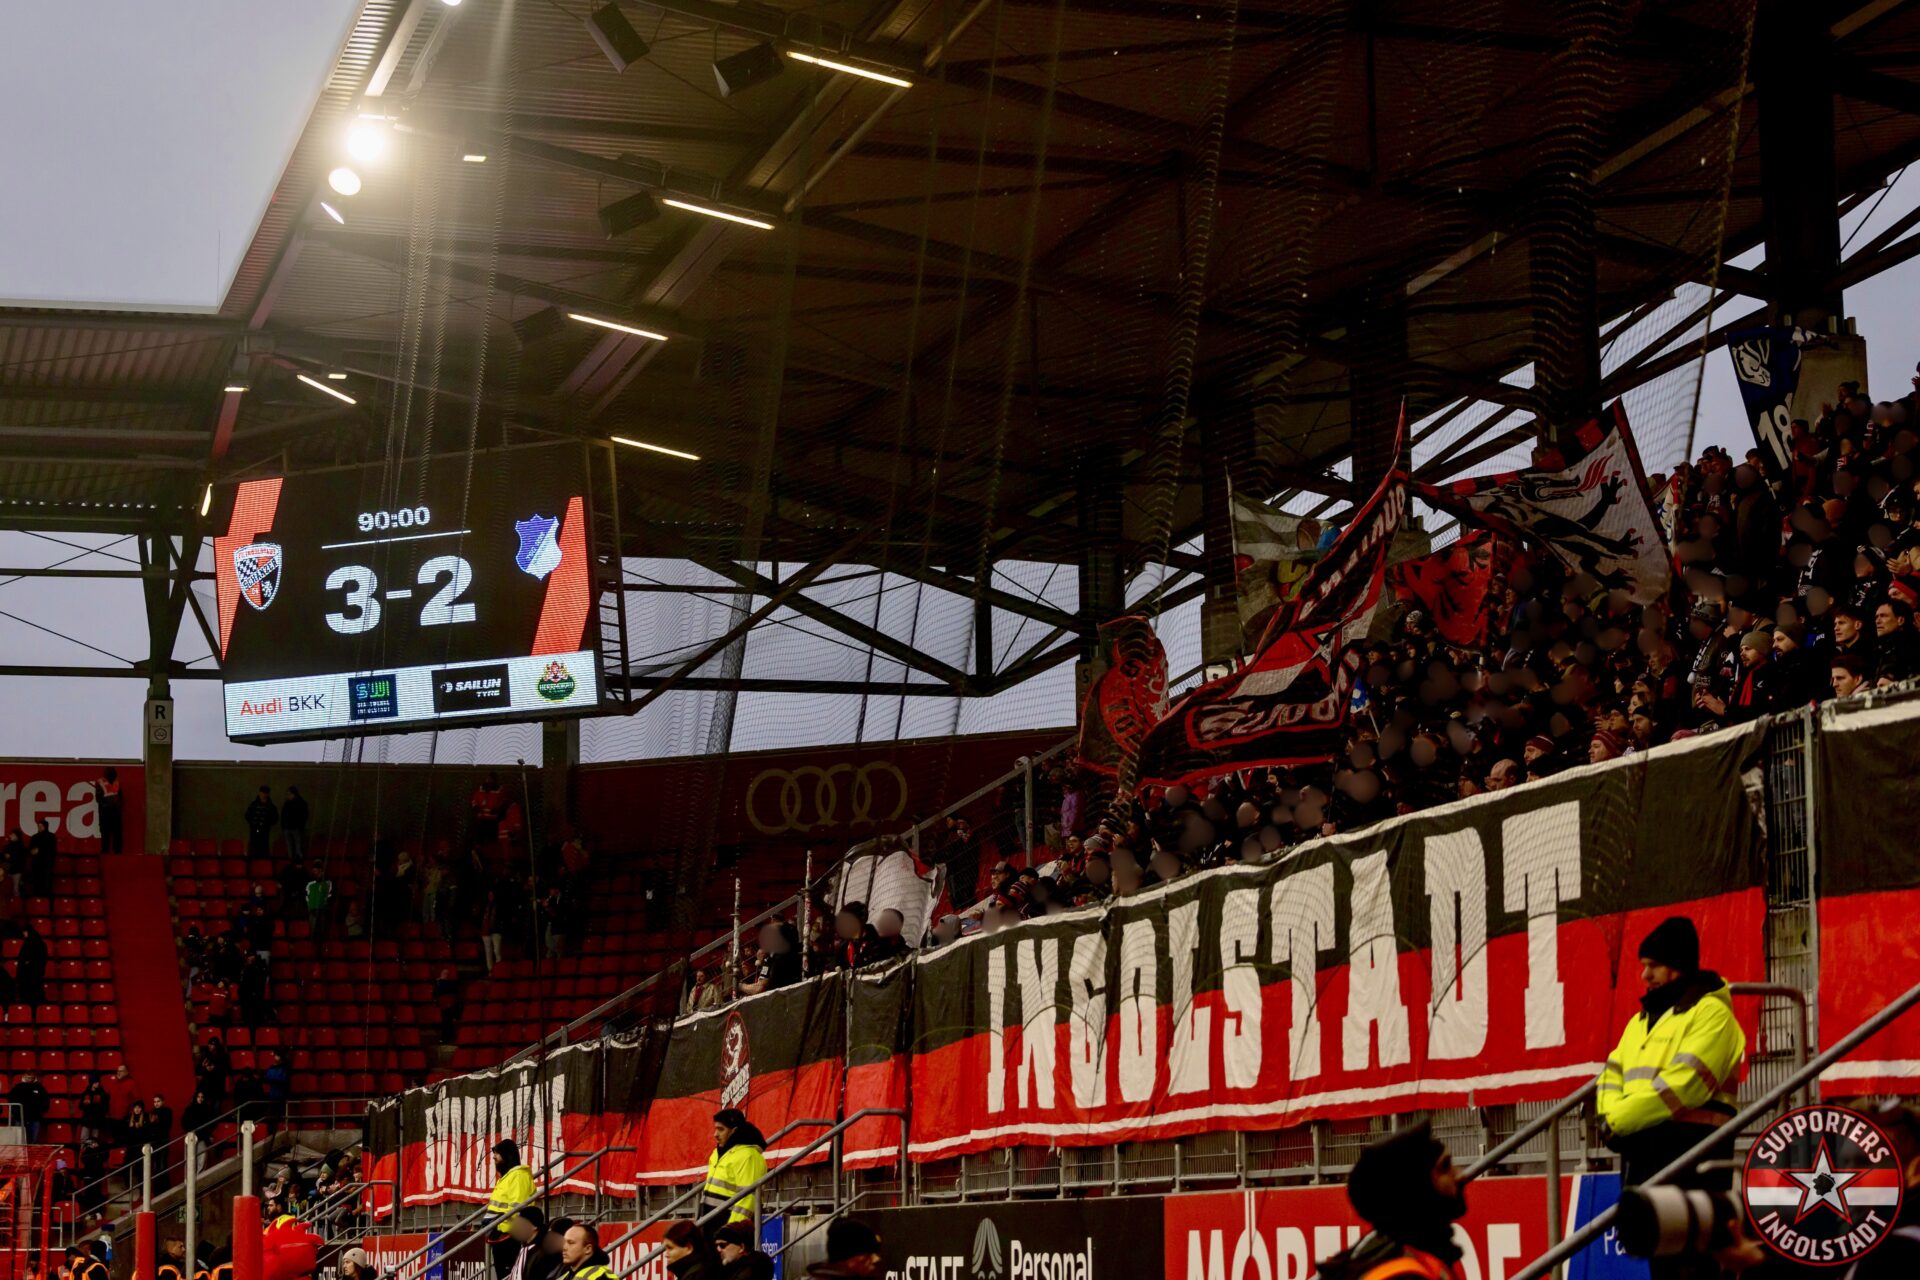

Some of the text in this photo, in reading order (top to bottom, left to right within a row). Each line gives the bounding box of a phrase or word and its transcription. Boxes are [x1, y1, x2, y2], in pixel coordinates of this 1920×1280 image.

[357, 506, 430, 532] 90:00
[455, 678, 501, 692] SAILUN
[476, 689, 500, 698] TYRE
[155, 704, 166, 720] R
[240, 694, 326, 717] Audi BKK
[987, 800, 1581, 1113] INGOLSTADT
[1010, 1236, 1093, 1280] Personal
